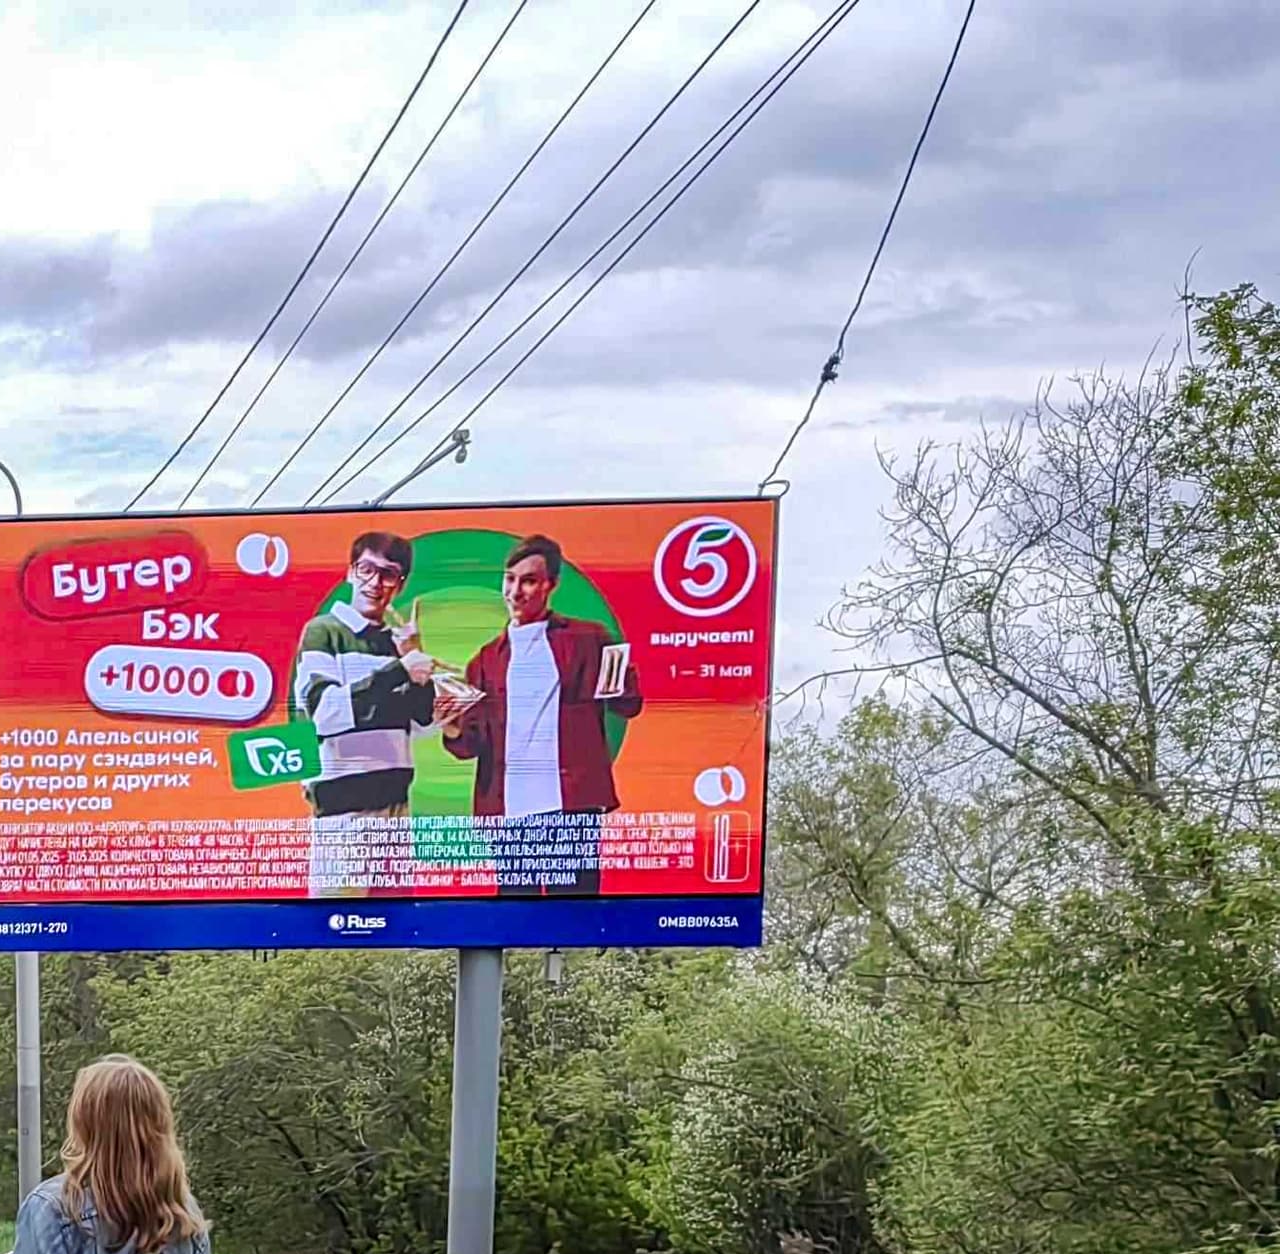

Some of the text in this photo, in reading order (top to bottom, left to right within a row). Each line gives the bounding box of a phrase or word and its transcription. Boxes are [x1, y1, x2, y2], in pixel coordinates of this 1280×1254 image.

[52, 555, 192, 603] Бутер
[142, 608, 220, 640] Бэк
[650, 629, 754, 647] выручает!
[100, 662, 210, 696] +1000
[670, 664, 677, 679] 1
[700, 664, 715, 678] 31
[719, 665, 752, 678] мая
[0, 728, 200, 747] +1000 Апельсинок
[0, 749, 218, 772] за пару сэндвичей,
[0, 773, 190, 792] бутеров и других
[556, 829, 580, 841] ДАТЫ
[535, 872, 576, 885] РЕКЛАМА
[347, 915, 387, 928] Russ
